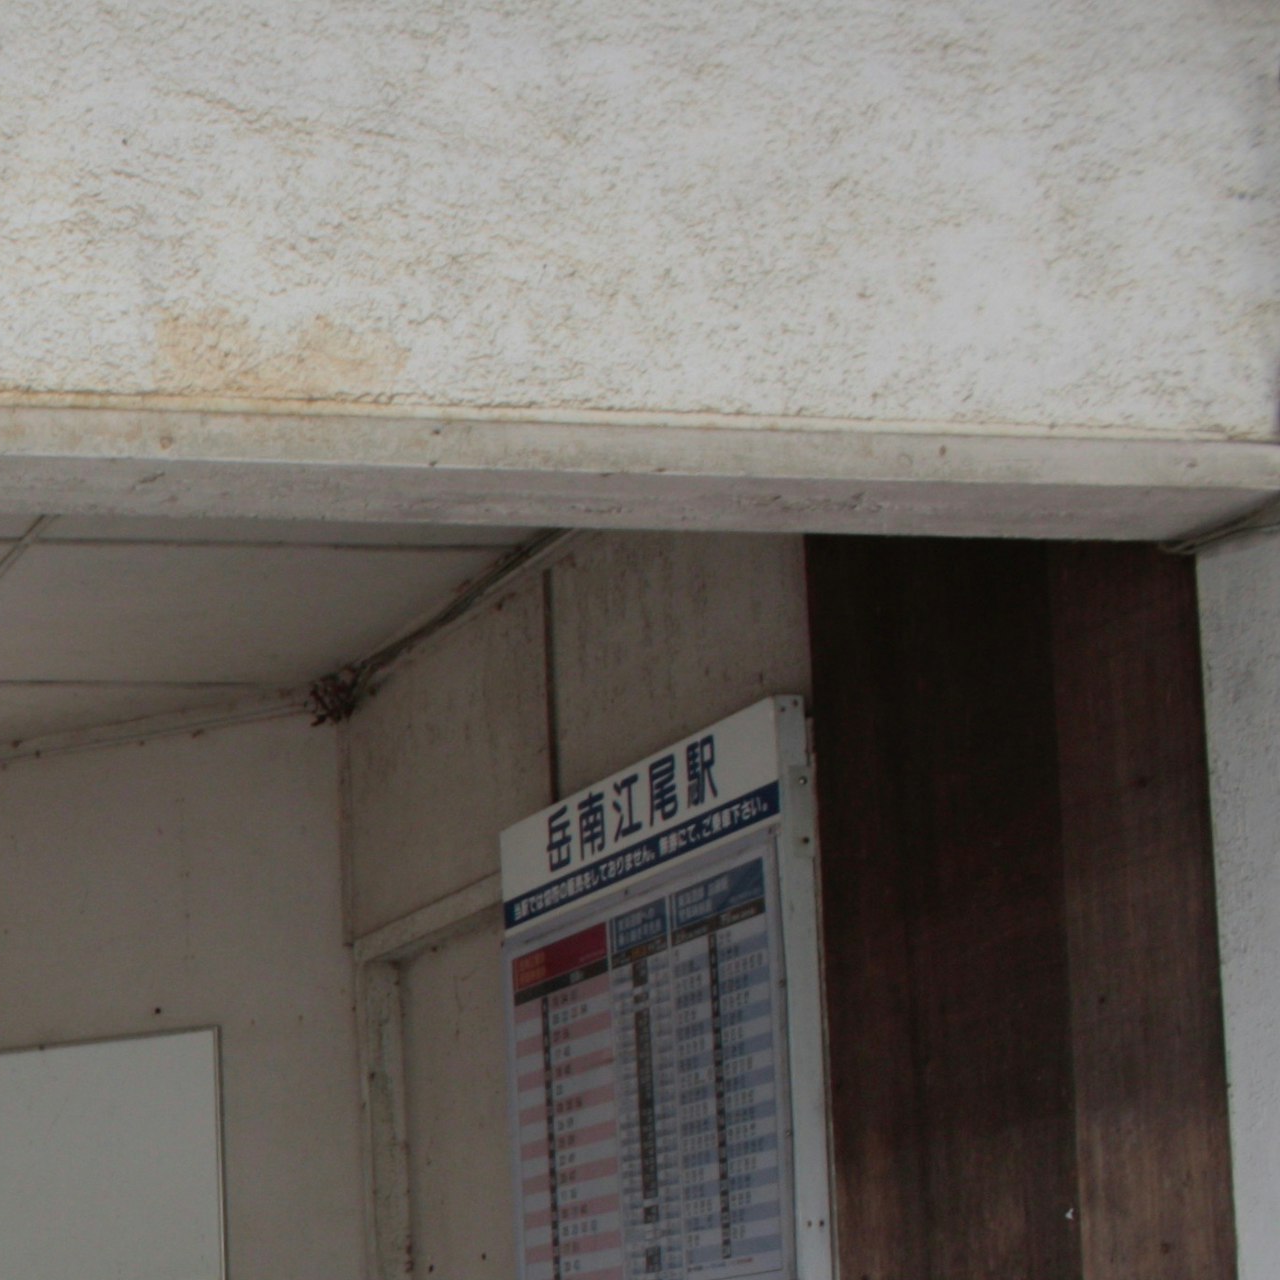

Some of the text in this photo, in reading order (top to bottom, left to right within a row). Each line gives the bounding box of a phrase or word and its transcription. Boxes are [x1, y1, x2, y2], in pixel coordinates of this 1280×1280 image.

[545, 735, 719, 874] 岳南江尾駅
